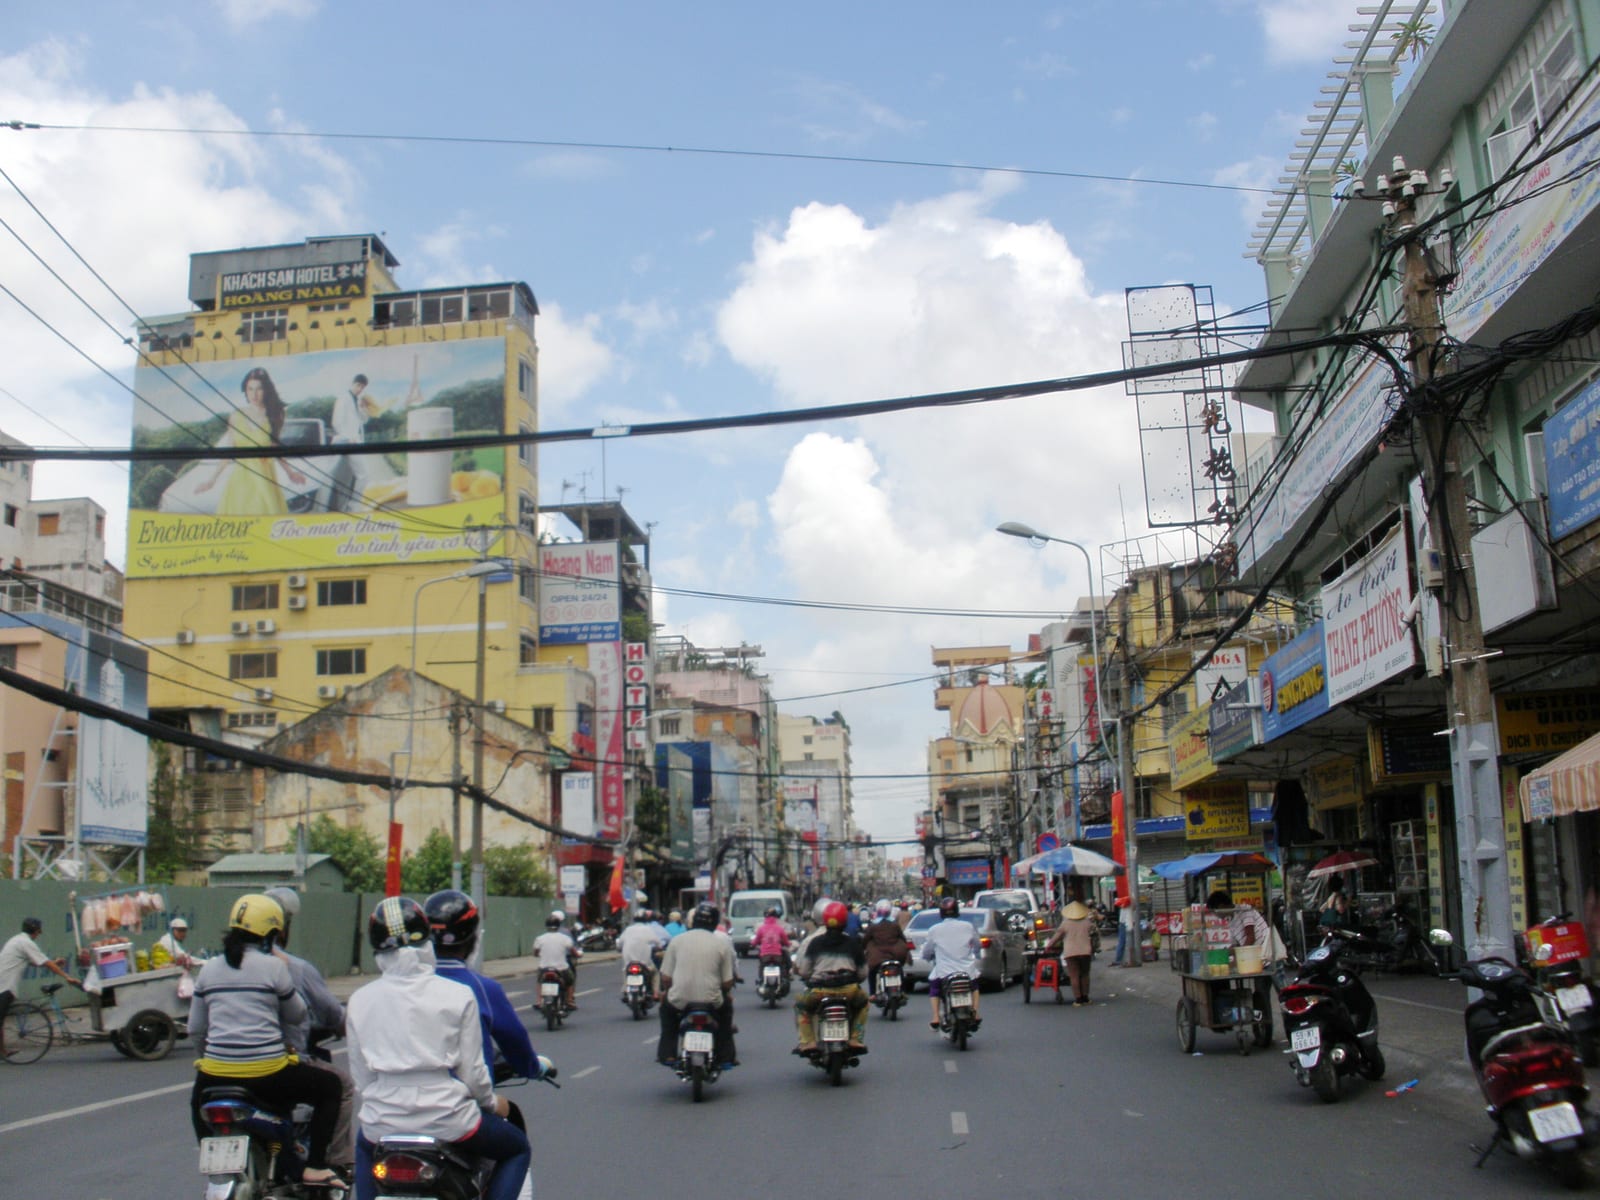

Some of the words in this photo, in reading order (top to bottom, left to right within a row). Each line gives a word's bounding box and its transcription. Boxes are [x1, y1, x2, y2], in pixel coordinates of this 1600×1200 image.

[223, 271, 265, 291] KHÁCH
[268, 269, 295, 289] SẠN
[296, 265, 337, 284] HOTEL
[296, 285, 341, 299] NAM
[346, 284, 361, 295] A
[138, 518, 253, 544] Enchanteur
[586, 549, 614, 575] Nam
[1327, 617, 1361, 678] THANH
[628, 644, 645, 748] HOTEL
